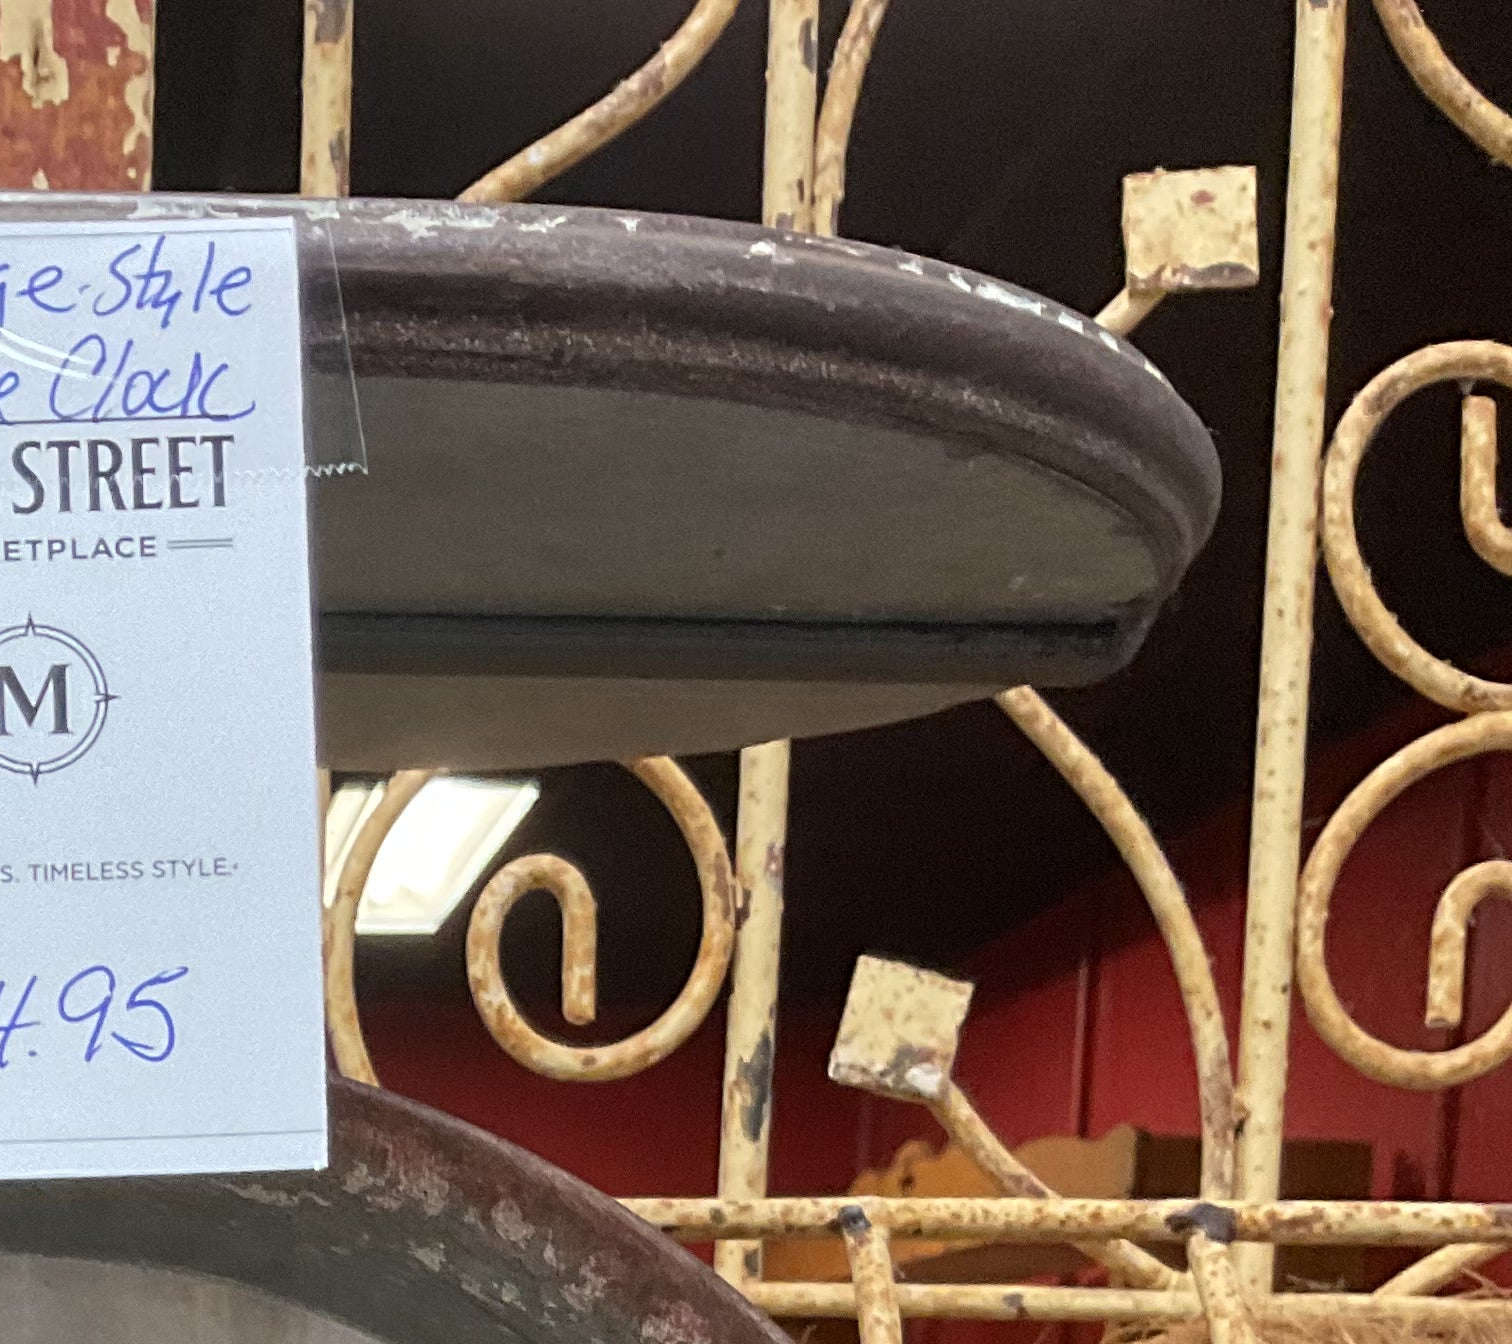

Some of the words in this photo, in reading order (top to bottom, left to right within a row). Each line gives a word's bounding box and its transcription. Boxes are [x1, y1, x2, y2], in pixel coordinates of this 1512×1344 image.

[50, 333, 256, 422] Clock
[12, 434, 235, 515] STREET
[28, 860, 144, 882] TIMELESS
